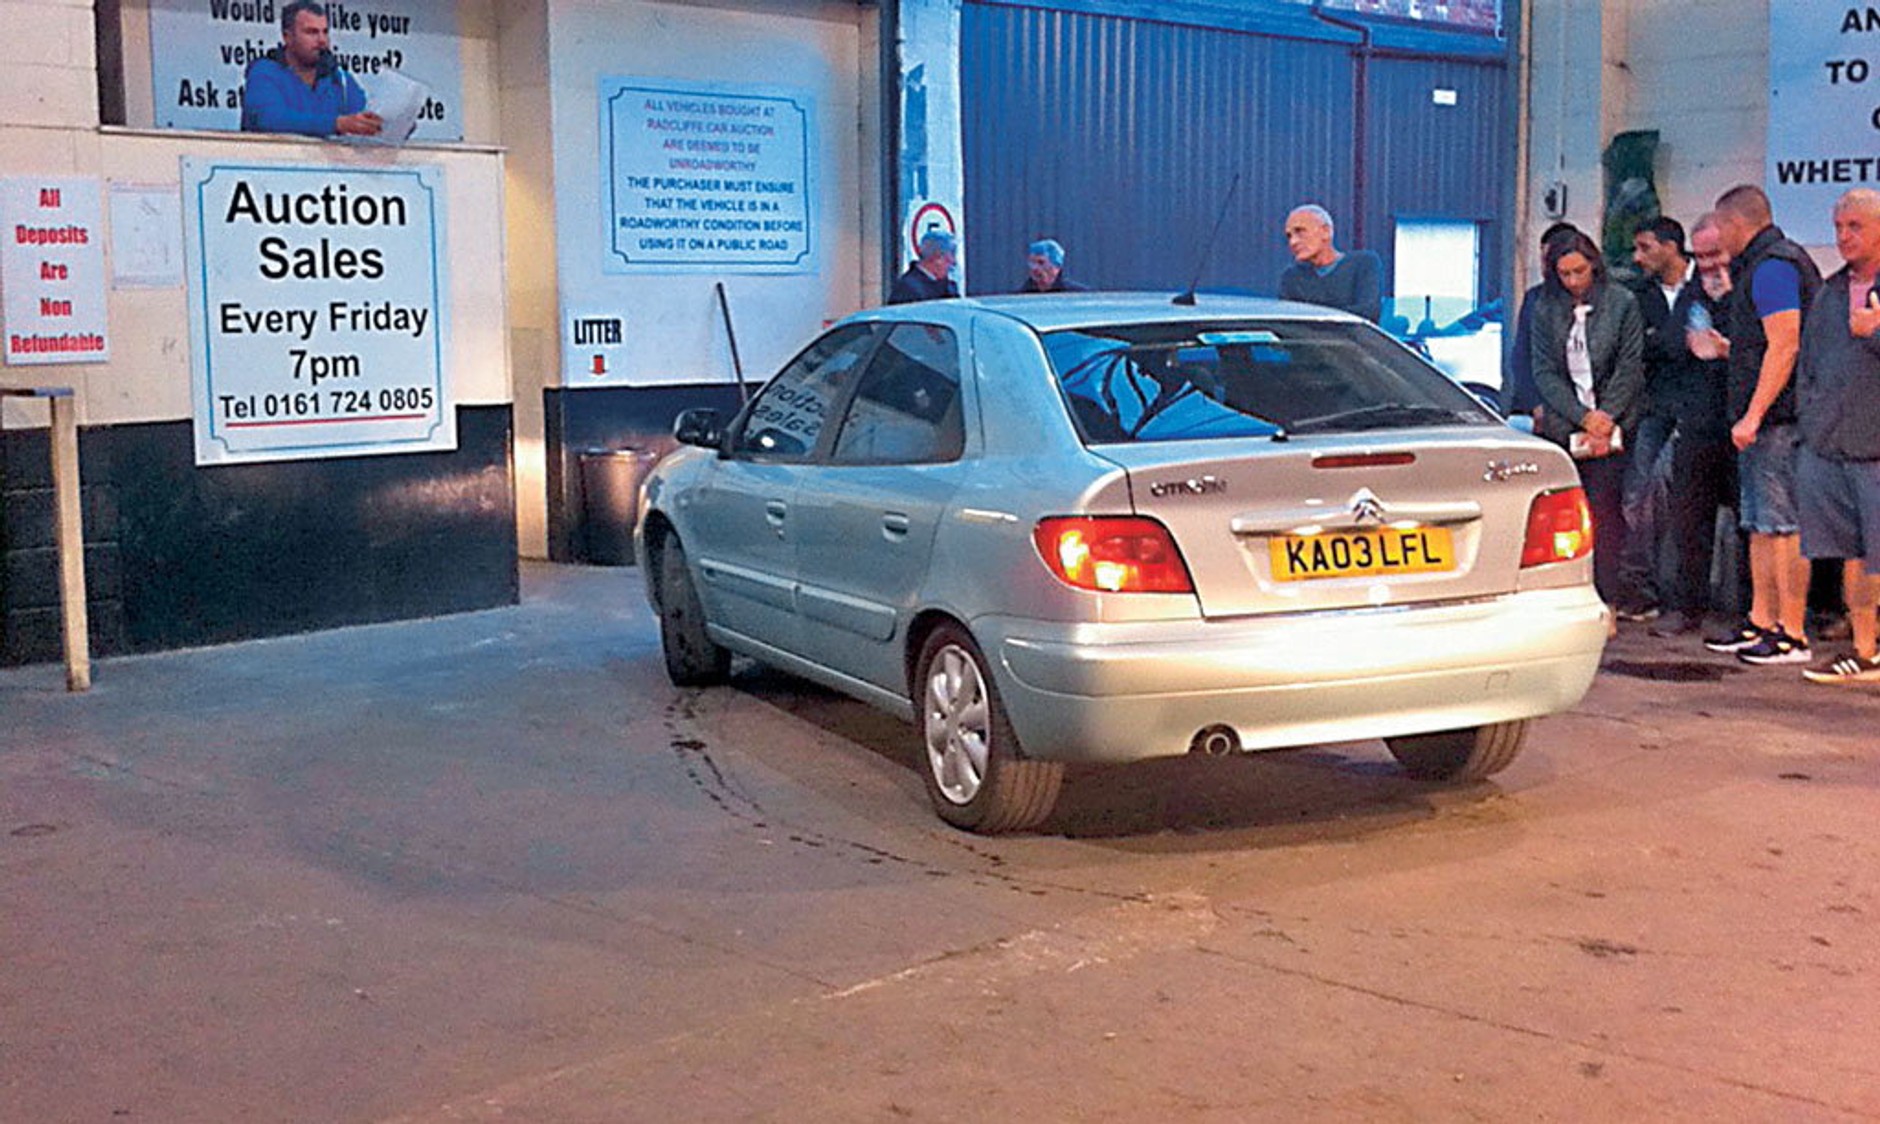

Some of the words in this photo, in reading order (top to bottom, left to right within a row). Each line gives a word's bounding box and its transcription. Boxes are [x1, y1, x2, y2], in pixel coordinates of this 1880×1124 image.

[210, 0, 275, 23] Would
[325, 3, 361, 31] like
[367, 13, 411, 38] your
[221, 39, 283, 65] vehic
[1825, 59, 1869, 84] TO
[178, 79, 219, 108] Ask
[645, 99, 664, 112] ALL
[666, 101, 716, 115] VEHICLES
[718, 103, 761, 117] BOUGHT
[762, 106, 775, 117] AT
[706, 121, 728, 135] CAR
[729, 123, 774, 137] AUCTION
[663, 139, 684, 151] ARE
[686, 139, 730, 153] DEEMED
[731, 142, 745, 154] TO
[748, 143, 760, 155] BE
[669, 158, 756, 172] UNROADWORTHY
[1777, 158, 1880, 184] WHET
[627, 176, 650, 189] THE
[653, 177, 721, 192] PURCHASER
[724, 179, 753, 192] MUST
[755, 181, 795, 194] ENSURE
[39, 187, 61, 208] All
[225, 181, 406, 226] Auction
[645, 197, 674, 209] THAT
[676, 198, 698, 211] THE
[701, 199, 745, 212] VEHICLE
[748, 201, 758, 212] IS
[760, 201, 771, 212] IN
[773, 202, 780, 211] A
[15, 223, 89, 246] Deposits
[620, 216, 700, 230] ROADWORTHY
[703, 218, 761, 232] CONDITION
[764, 220, 803, 233] BEFORE
[639, 238, 674, 250] USING
[676, 238, 687, 250] IT
[689, 238, 705, 250] ON
[706, 239, 715, 250] A
[718, 239, 756, 251] PUBLIC
[759, 239, 788, 251] ROAD
[259, 236, 385, 279] Sales
[40, 261, 68, 280] Are
[40, 298, 72, 316] Non
[220, 302, 317, 341] Every
[329, 301, 428, 338] Friday
[574, 318, 622, 346] LITTER
[10, 331, 105, 353] Refundable
[289, 349, 360, 386] 7pm
[219, 395, 256, 419] Tel
[264, 392, 320, 417] 0161
[330, 390, 372, 413] 724
[379, 387, 433, 411] 0805
[1285, 535, 1373, 574] KA03
[1379, 532, 1442, 566] LFL
